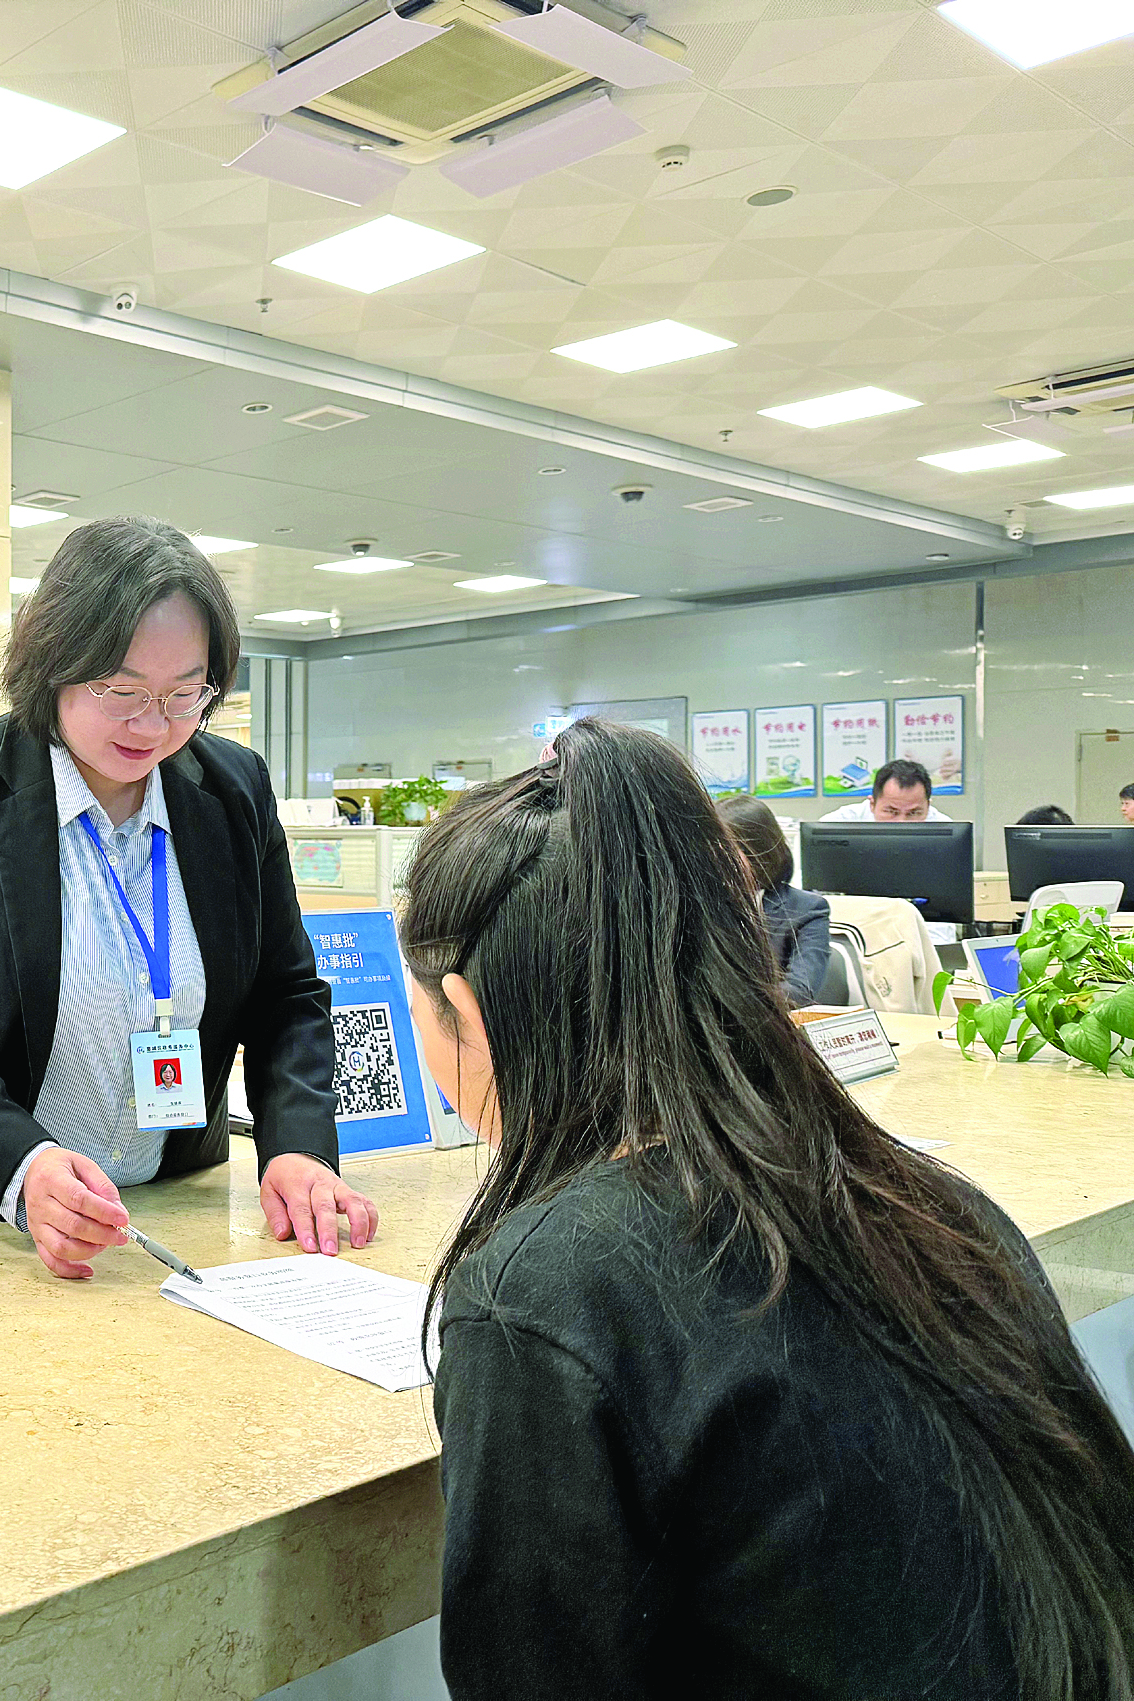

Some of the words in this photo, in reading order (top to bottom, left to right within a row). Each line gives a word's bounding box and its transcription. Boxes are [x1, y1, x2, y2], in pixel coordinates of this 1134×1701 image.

[313, 932, 359, 949] “智惠批”
[317, 952, 364, 969] 办事指引
